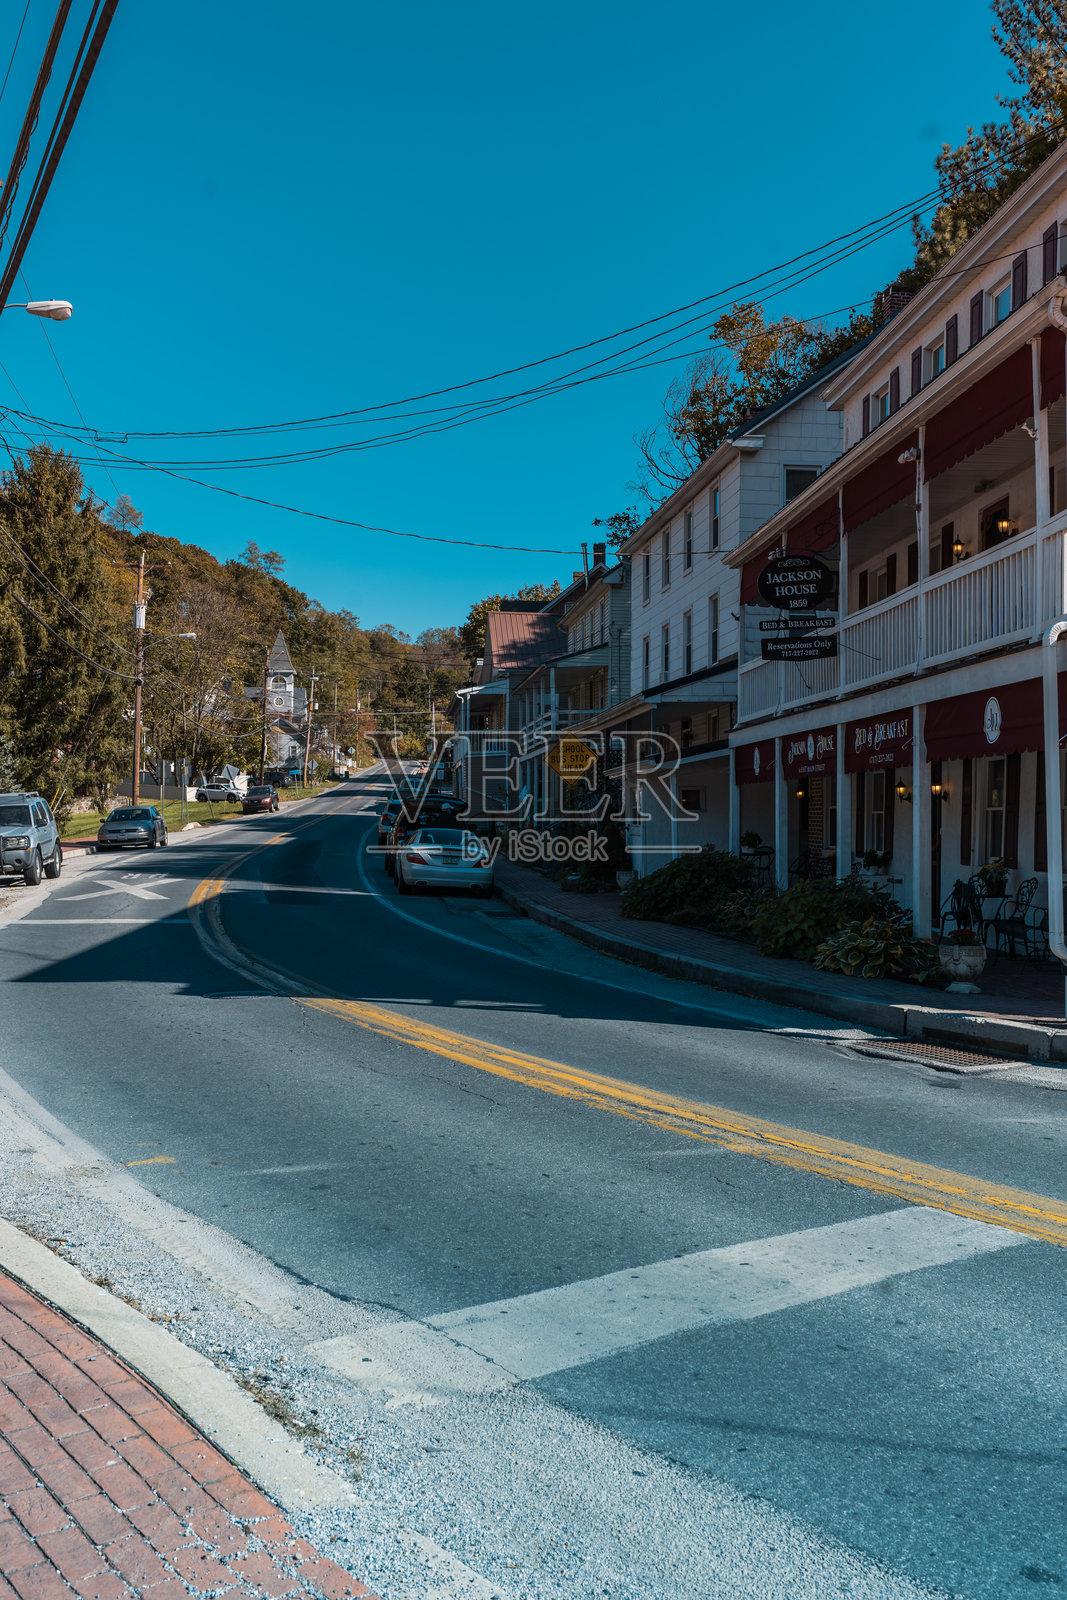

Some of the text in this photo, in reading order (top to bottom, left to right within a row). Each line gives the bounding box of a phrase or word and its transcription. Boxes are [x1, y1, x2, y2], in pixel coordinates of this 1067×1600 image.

[766, 570, 822, 584] JACKSON
[775, 584, 818, 596] HOUSE
[789, 599, 808, 608] 1859
[762, 619, 834, 629] BED & BREAKFAST
[767, 640, 832, 651] Reservations Only
[874, 719, 909, 750] BREAKFAST
[570, 754, 590, 763] STOP
